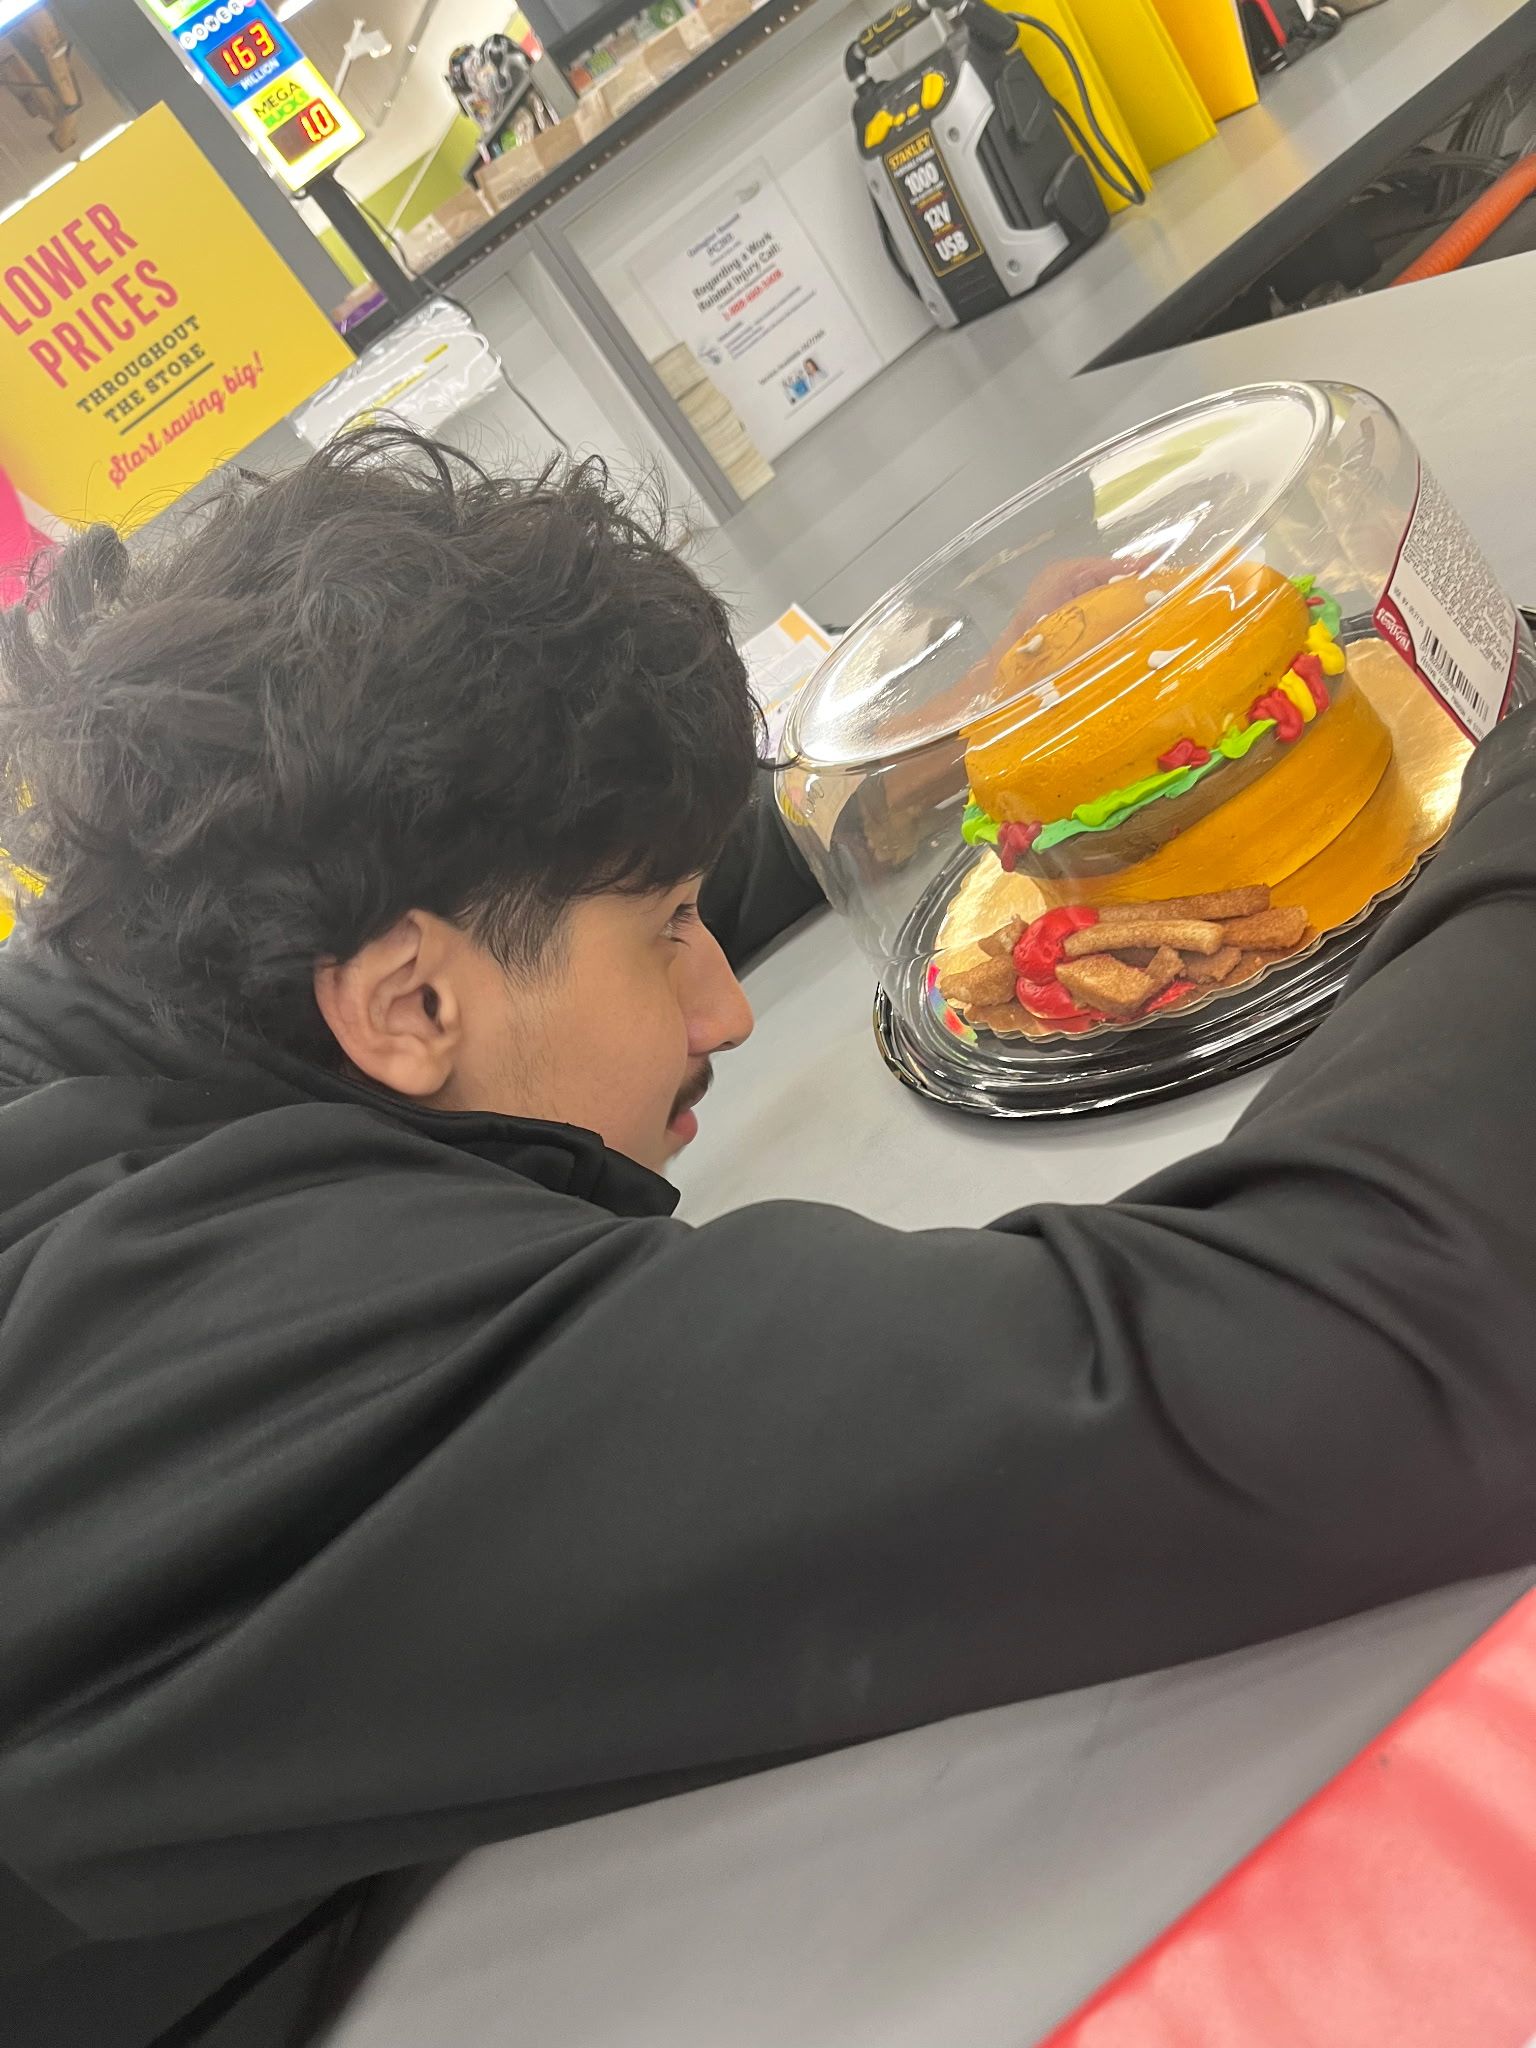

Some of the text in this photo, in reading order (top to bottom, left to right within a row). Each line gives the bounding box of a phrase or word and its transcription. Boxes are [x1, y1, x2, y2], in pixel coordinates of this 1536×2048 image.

[182, 1, 243, 46] POWER
[221, 21, 275, 76] 163
[240, 57, 281, 90] MILLION
[253, 81, 302, 118] MEGA
[888, 134, 931, 169] STANLEY
[904, 162, 940, 196] 1000
[923, 200, 952, 230] 12V
[0, 203, 138, 336] LOWER
[692, 258, 742, 299] Regarding
[746, 232, 772, 255] Work
[934, 230, 969, 261] USB
[698, 279, 734, 313] Related
[731, 260, 761, 287] Injury
[28, 259, 179, 389] PRICES
[76, 314, 200, 414] THROUGHOUT
[104, 343, 206, 424] THE STORE
[108, 350, 265, 490] Start saving big!
